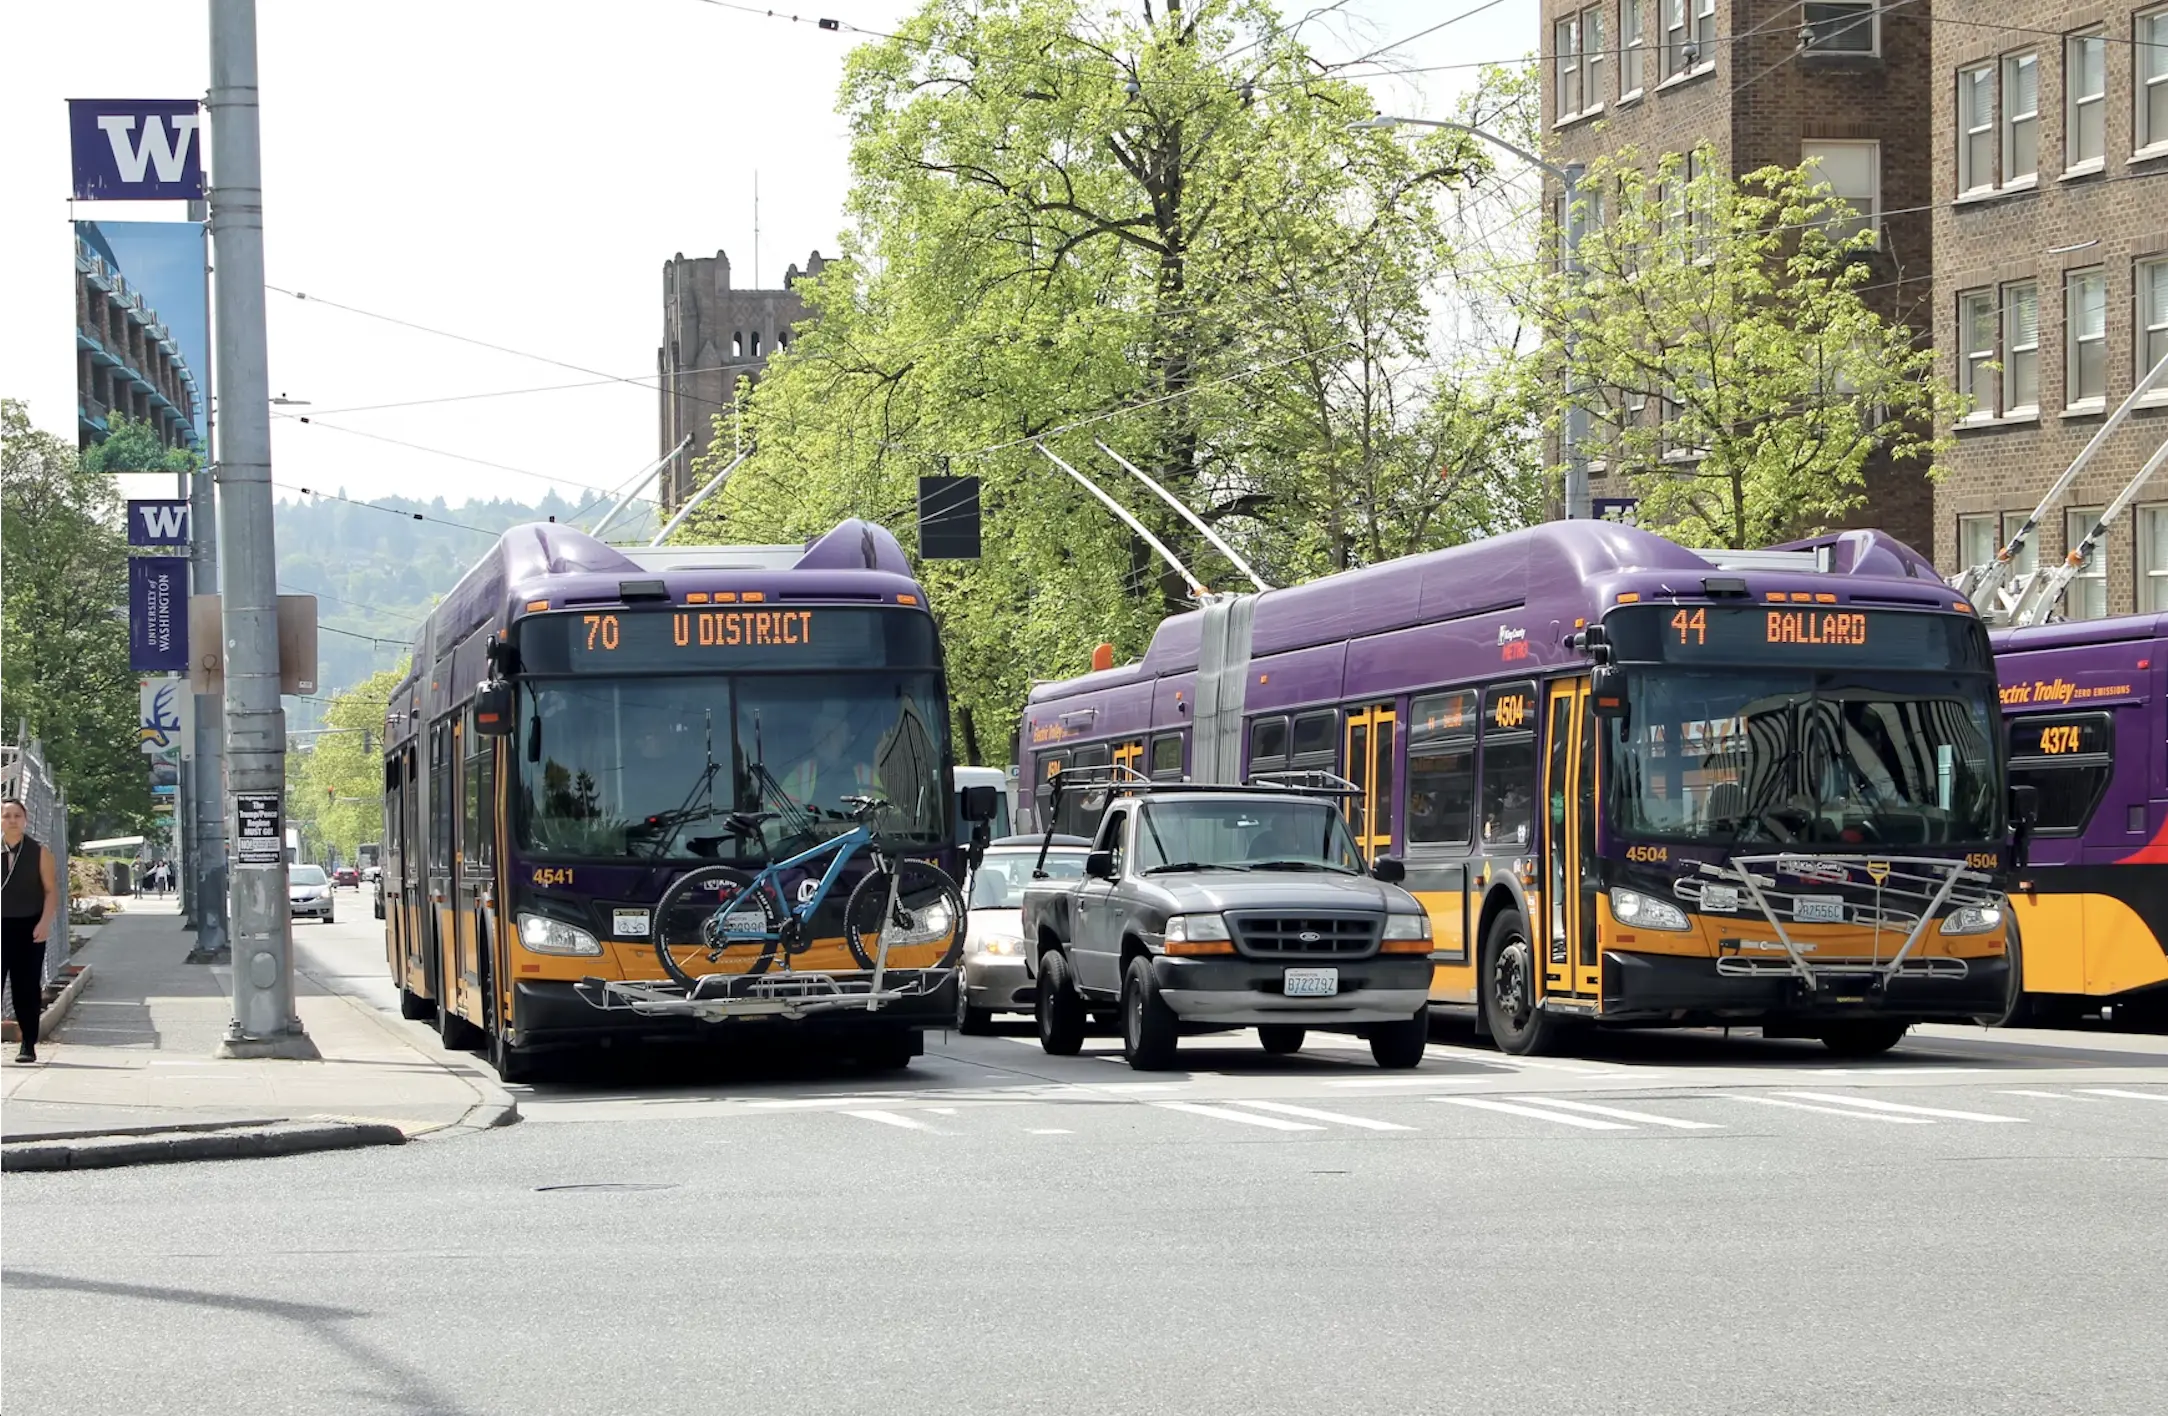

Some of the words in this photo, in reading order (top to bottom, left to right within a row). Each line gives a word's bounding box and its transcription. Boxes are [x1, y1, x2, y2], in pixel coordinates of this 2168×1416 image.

[97, 115, 199, 182] W
[139, 506, 187, 538] W
[149, 579, 157, 589] of
[148, 590, 157, 645] UNIVERSITY
[159, 574, 169, 652] WASHINGTON
[1671, 608, 1706, 645] 44
[1766, 612, 1865, 645] BALLARD
[583, 615, 619, 650] 70
[673, 613, 689, 646] U
[699, 611, 812, 645] DISTRICT
[2034, 679, 2075, 704] Trolley
[2074, 689, 2091, 699] ZERO
[2093, 685, 2131, 698] EMISSIONS
[1495, 694, 1524, 728] 4504
[2040, 726, 2079, 754] 4374
[1626, 846, 1667, 861] 4504
[533, 868, 574, 885] 4541
